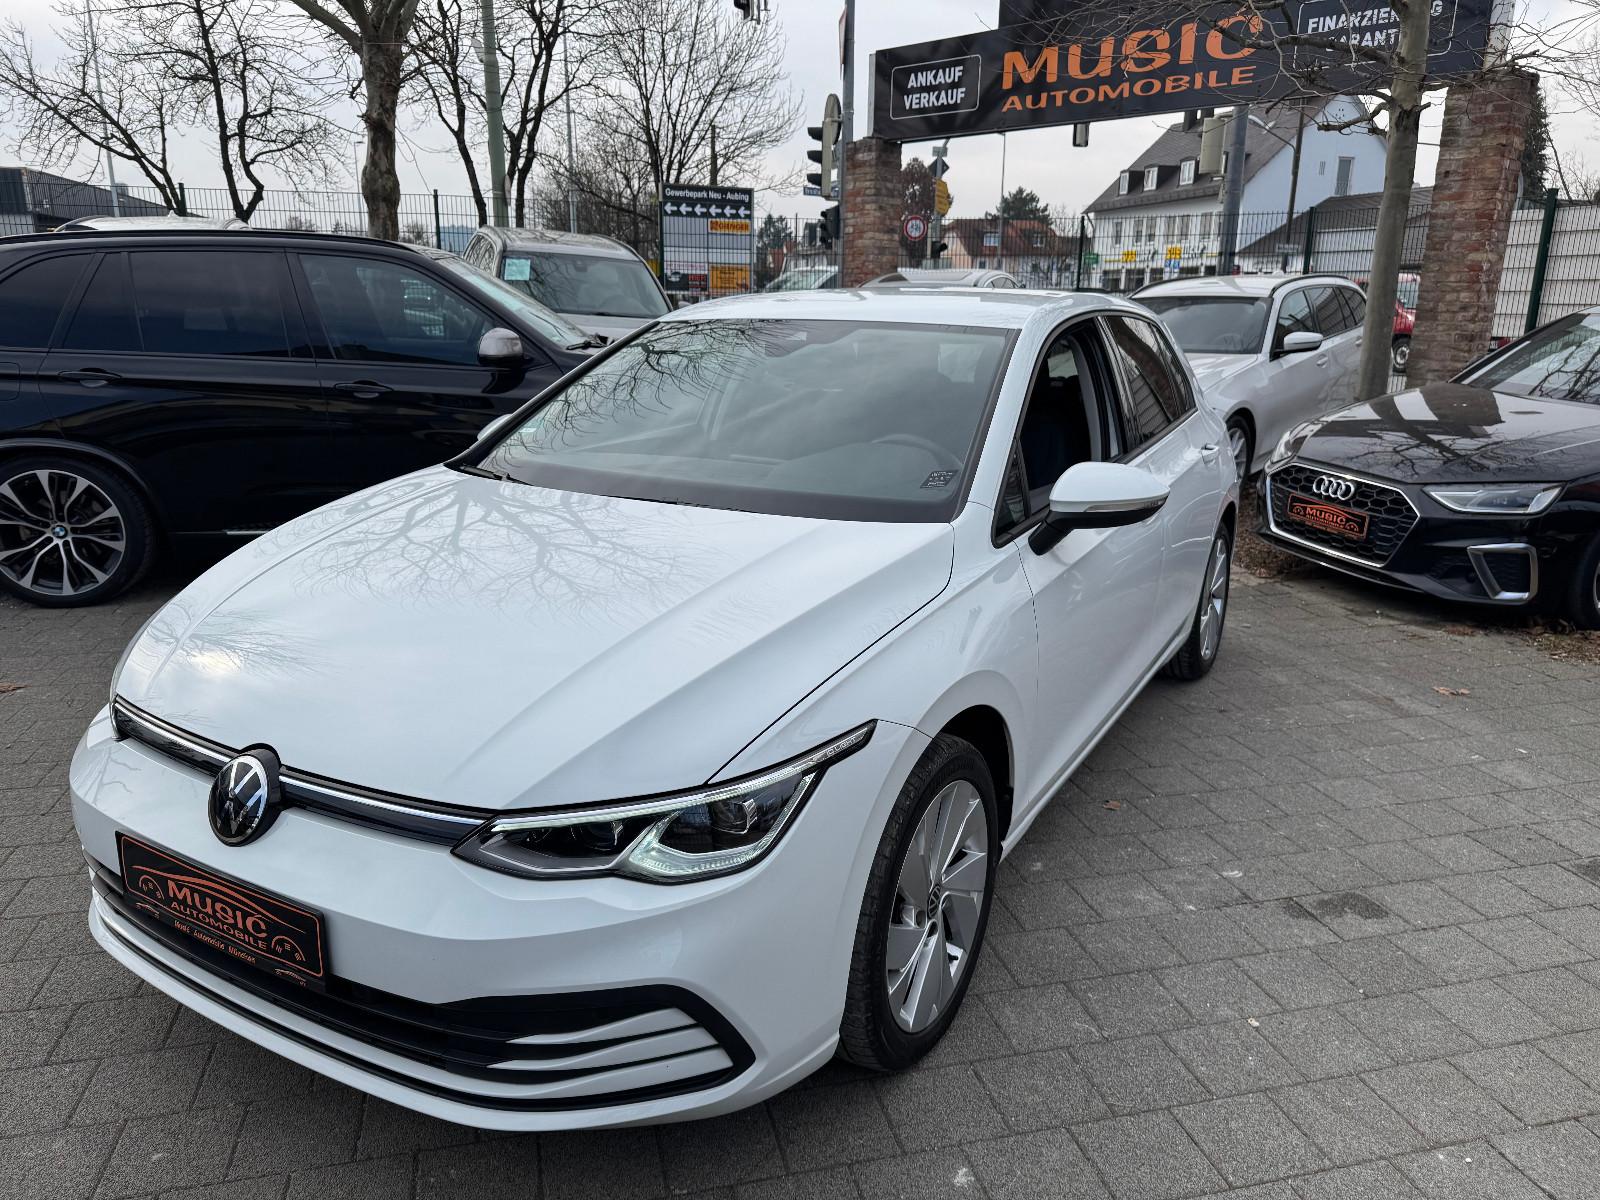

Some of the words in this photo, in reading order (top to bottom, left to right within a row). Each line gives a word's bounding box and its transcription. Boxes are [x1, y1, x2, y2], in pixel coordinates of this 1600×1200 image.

[908, 66, 963, 89] ANKAUF
[1001, 65, 1257, 113] AUTOMOBILE
[904, 87, 965, 110] VERKAUF
[665, 188, 707, 199] Gewerbepark
[709, 190, 721, 198] Neu
[726, 191, 749, 202] Aubing
[170, 901, 267, 950] AUTOMOBILE
